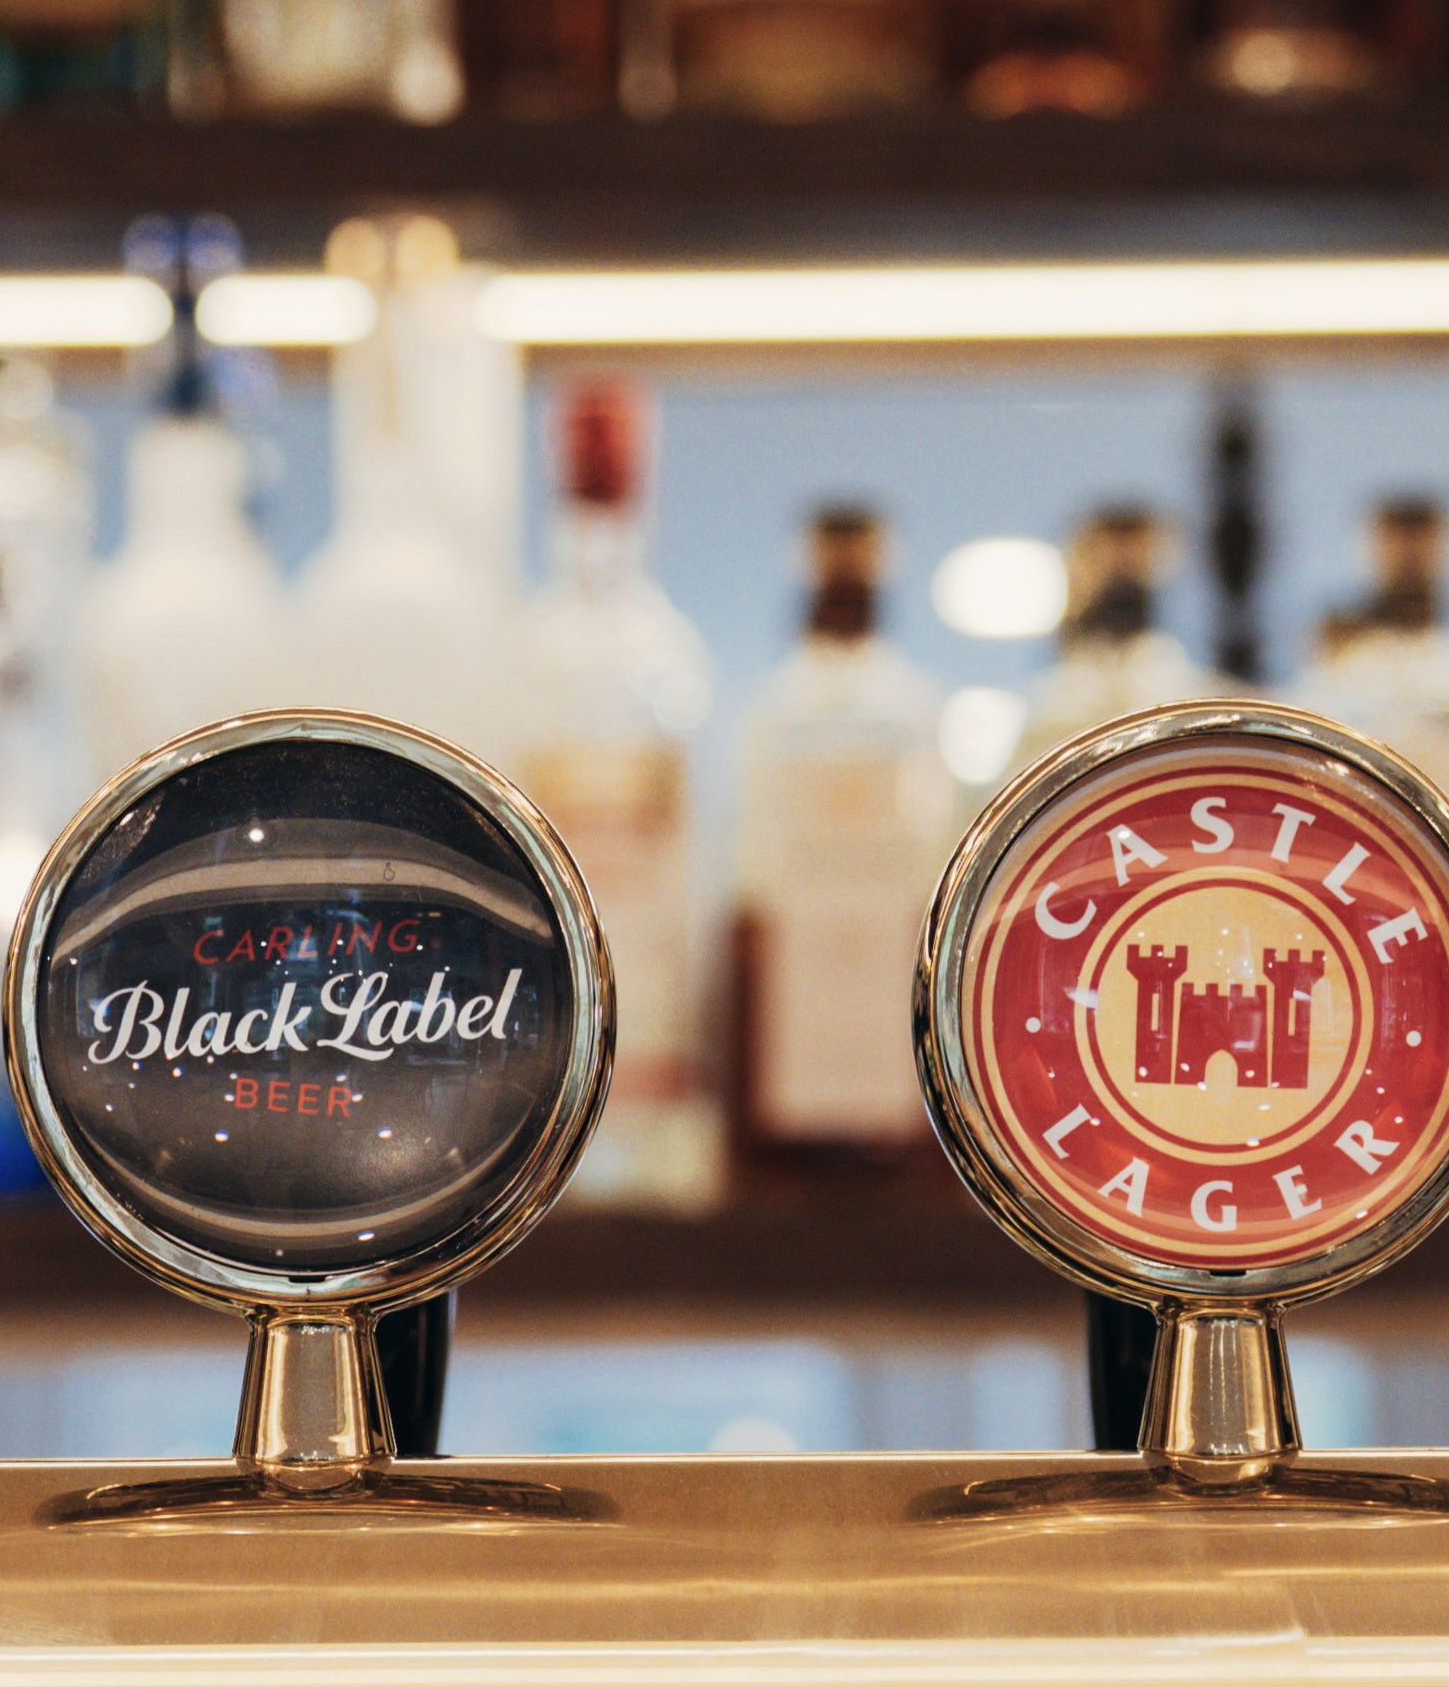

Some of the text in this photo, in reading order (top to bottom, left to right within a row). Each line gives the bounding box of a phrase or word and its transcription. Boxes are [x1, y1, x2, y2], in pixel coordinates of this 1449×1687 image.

[1033, 796, 1429, 965] CASTLE
[192, 919, 421, 966] CARLING
[87, 968, 523, 1065] Black Label
[234, 1077, 352, 1117] BEER
[1042, 1104, 1400, 1233] LAGER
